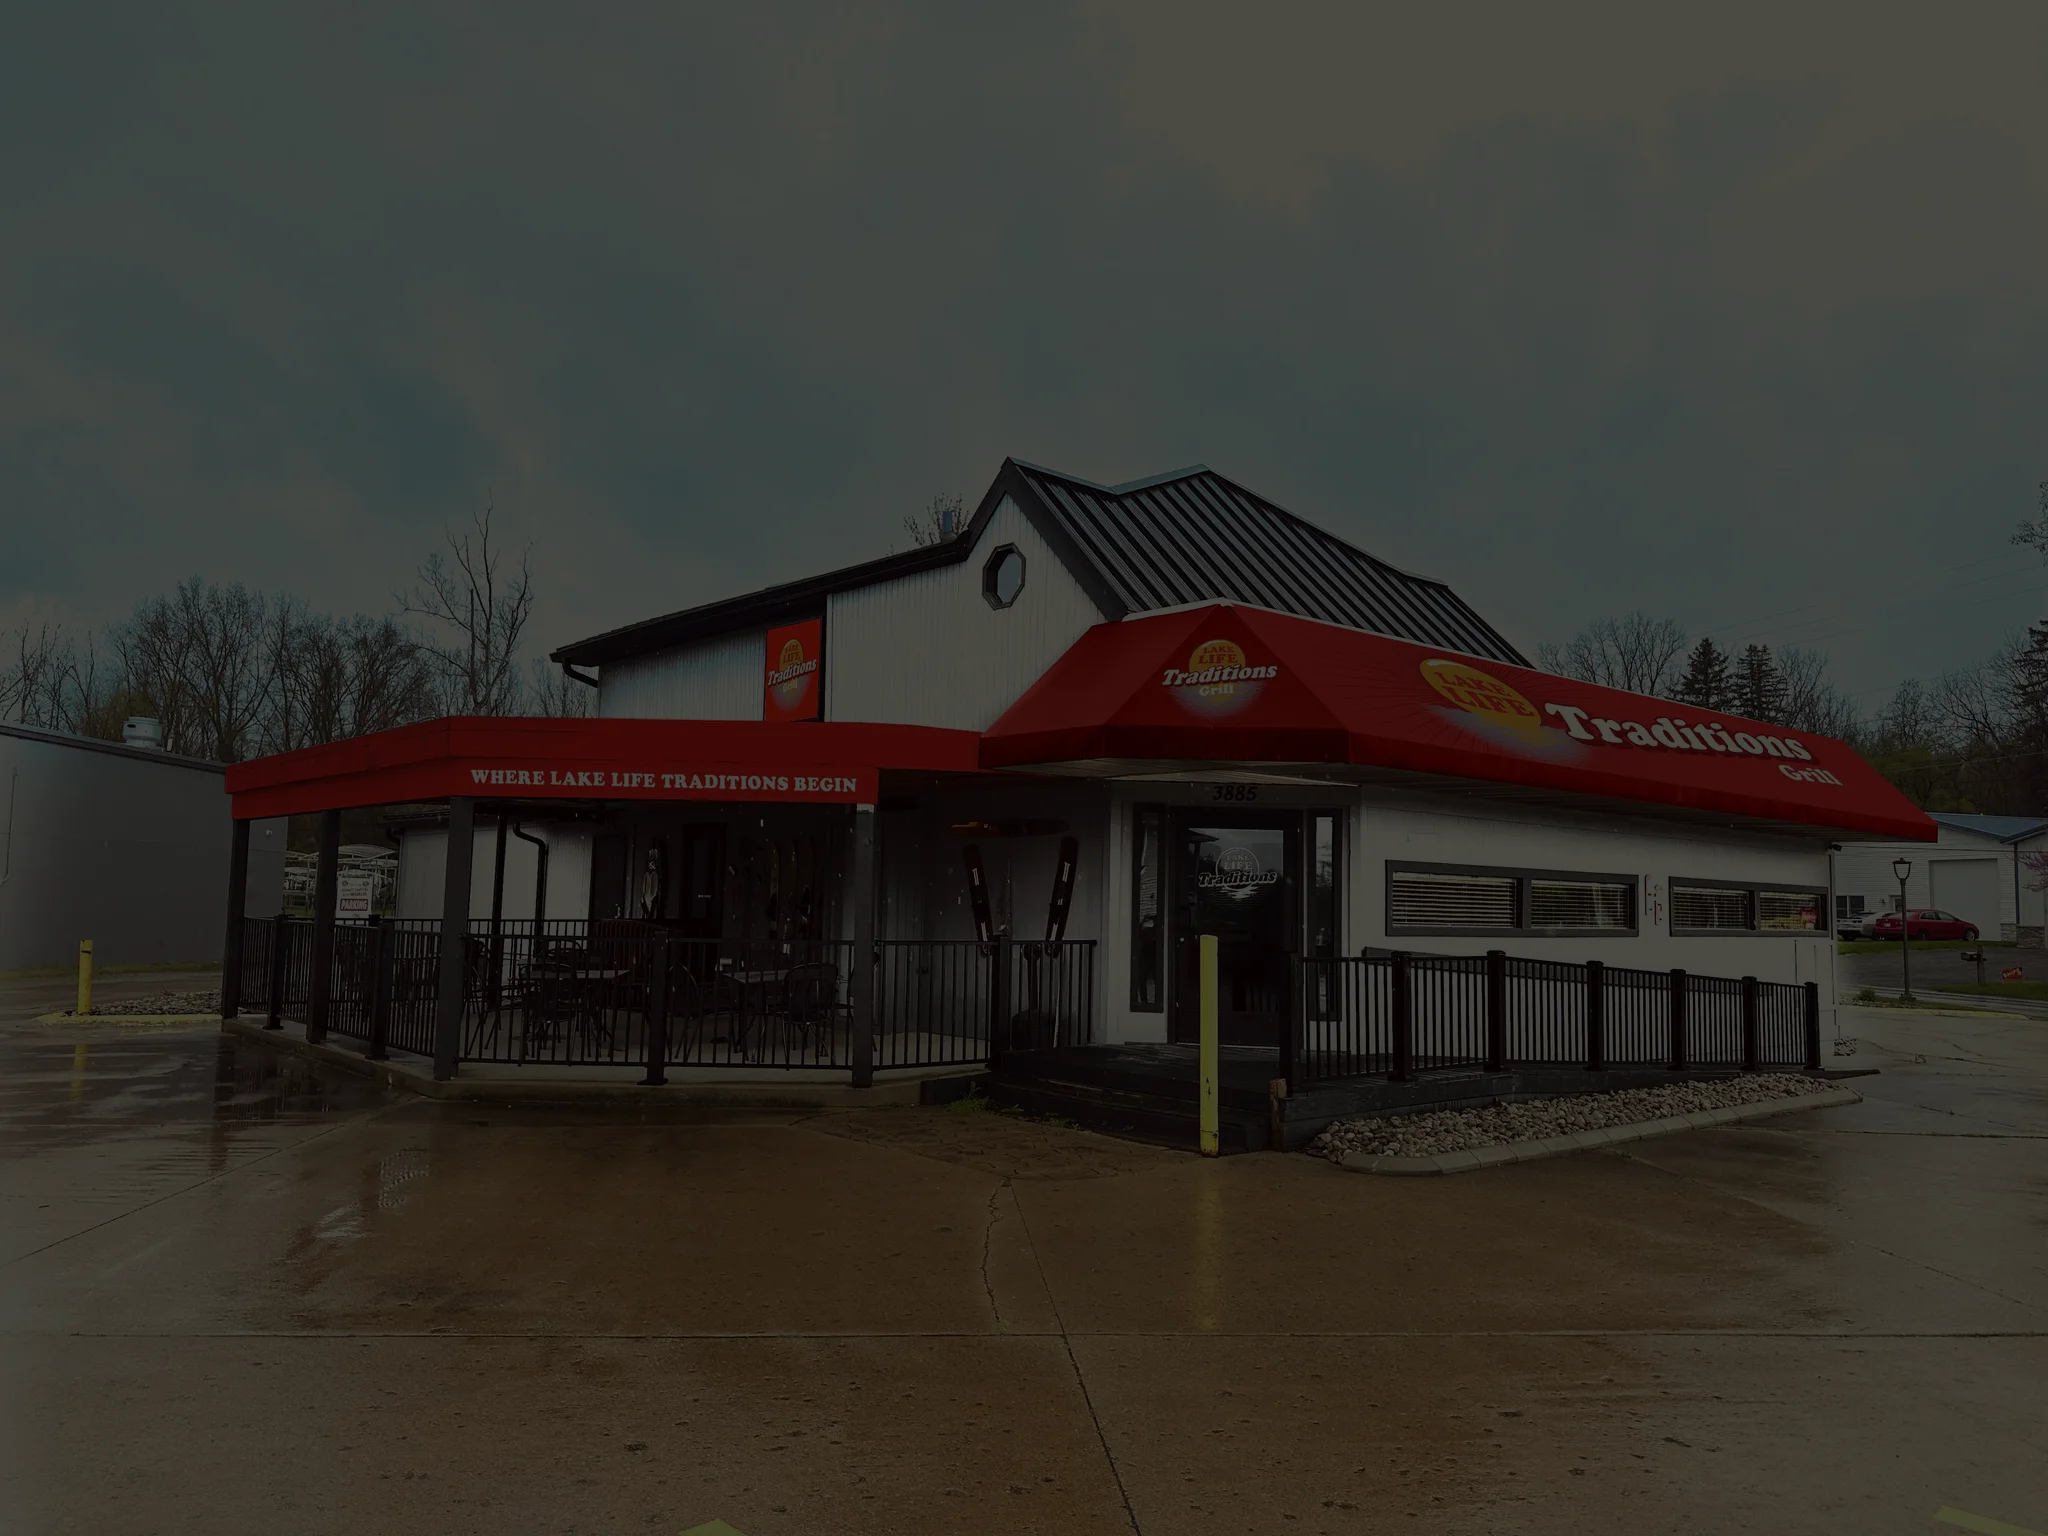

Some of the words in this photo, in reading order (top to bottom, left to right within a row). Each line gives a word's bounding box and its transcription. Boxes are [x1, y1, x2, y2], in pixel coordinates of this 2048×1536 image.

[1198, 654, 1238, 664] LIFE
[1203, 645, 1234, 654] LAKE
[768, 659, 816, 686] Traditions
[1162, 664, 1278, 686] Traditions
[1199, 683, 1234, 696] Grill
[1435, 671, 1515, 698] LAKE
[1441, 685, 1537, 718] LIFE
[1545, 702, 1814, 762] Traditions
[470, 769, 545, 786] WHERE
[550, 770, 606, 787] LAKE
[611, 772, 656, 788] LIFE
[661, 773, 789, 791] TRADITIONS
[793, 776, 857, 793] BEGIN
[1778, 764, 1843, 786] Grill
[1212, 785, 1258, 801] 3885
[1223, 861, 1253, 870] LIFE
[1198, 871, 1278, 887] Traditions
[341, 900, 368, 910] PARKING
